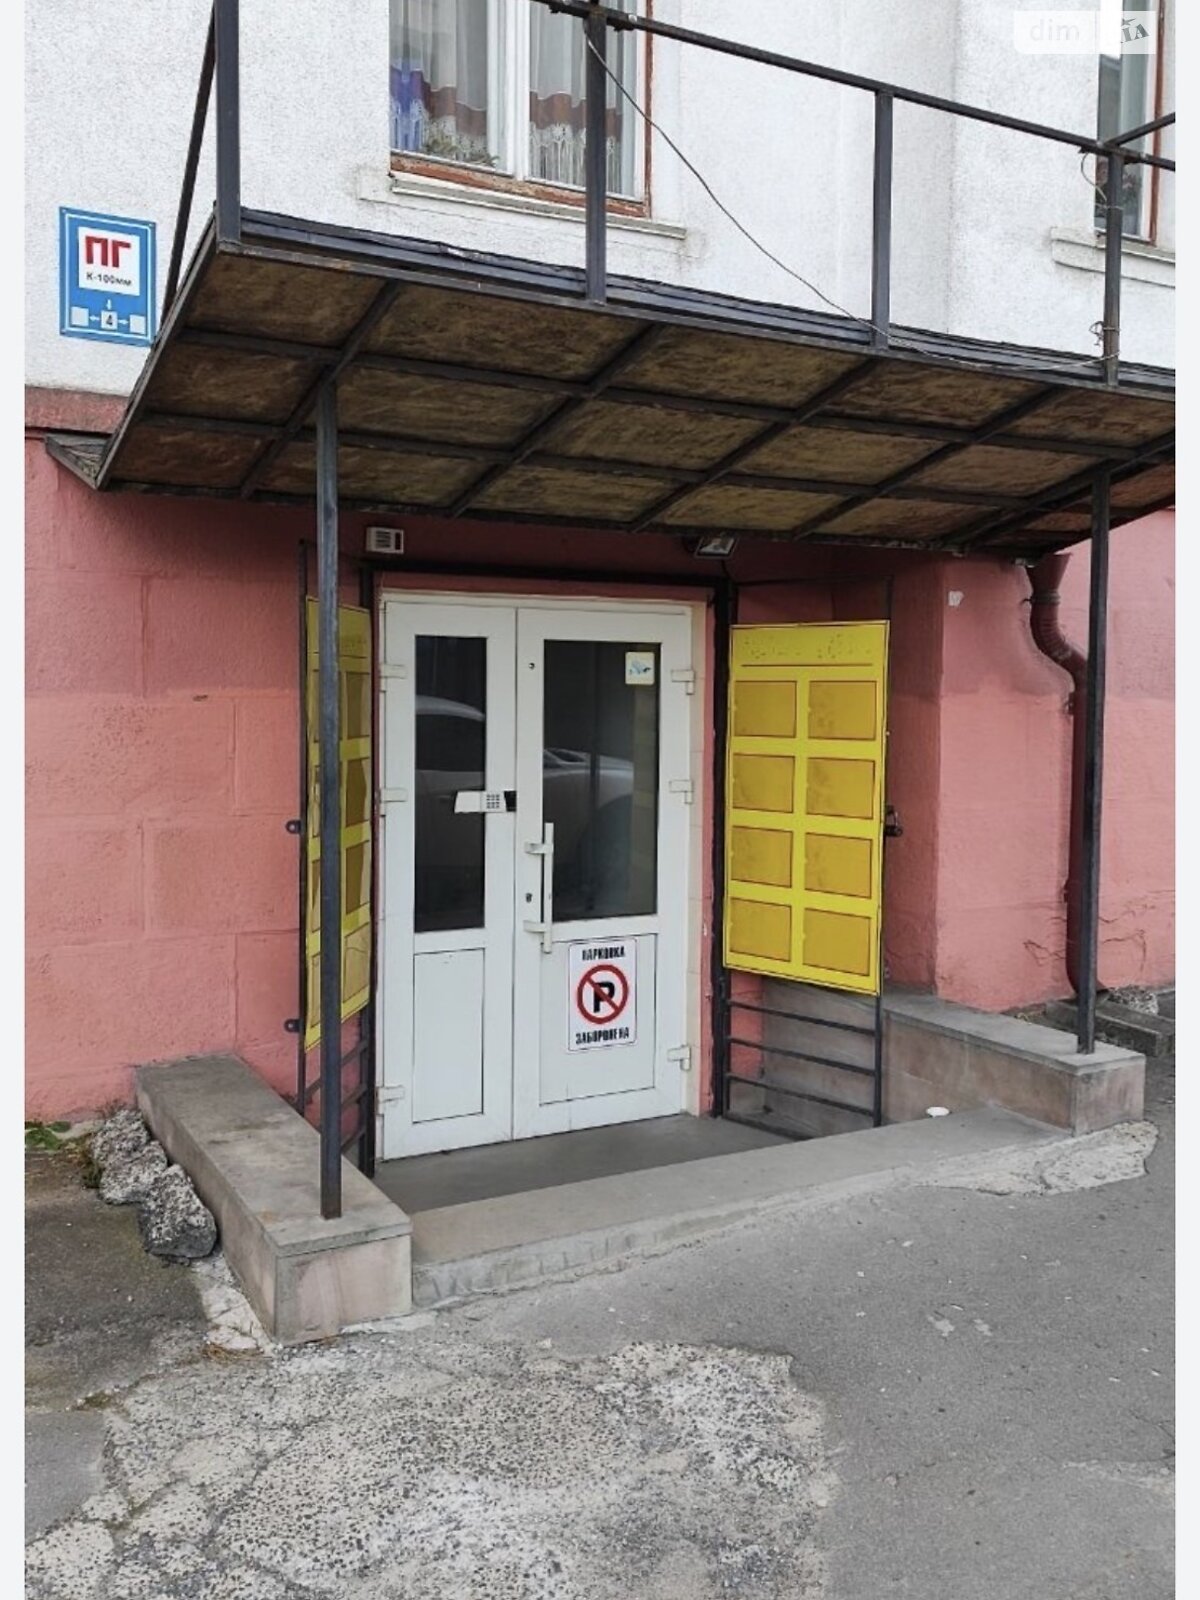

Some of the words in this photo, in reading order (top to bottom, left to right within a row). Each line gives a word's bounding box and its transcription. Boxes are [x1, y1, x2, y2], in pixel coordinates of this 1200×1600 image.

[85, 235, 131, 268] ПГ
[105, 314, 113, 326] 4
[582, 945, 625, 961] ПАРКОВКА
[575, 1026, 630, 1045] ЗАБОРОНЕНА
